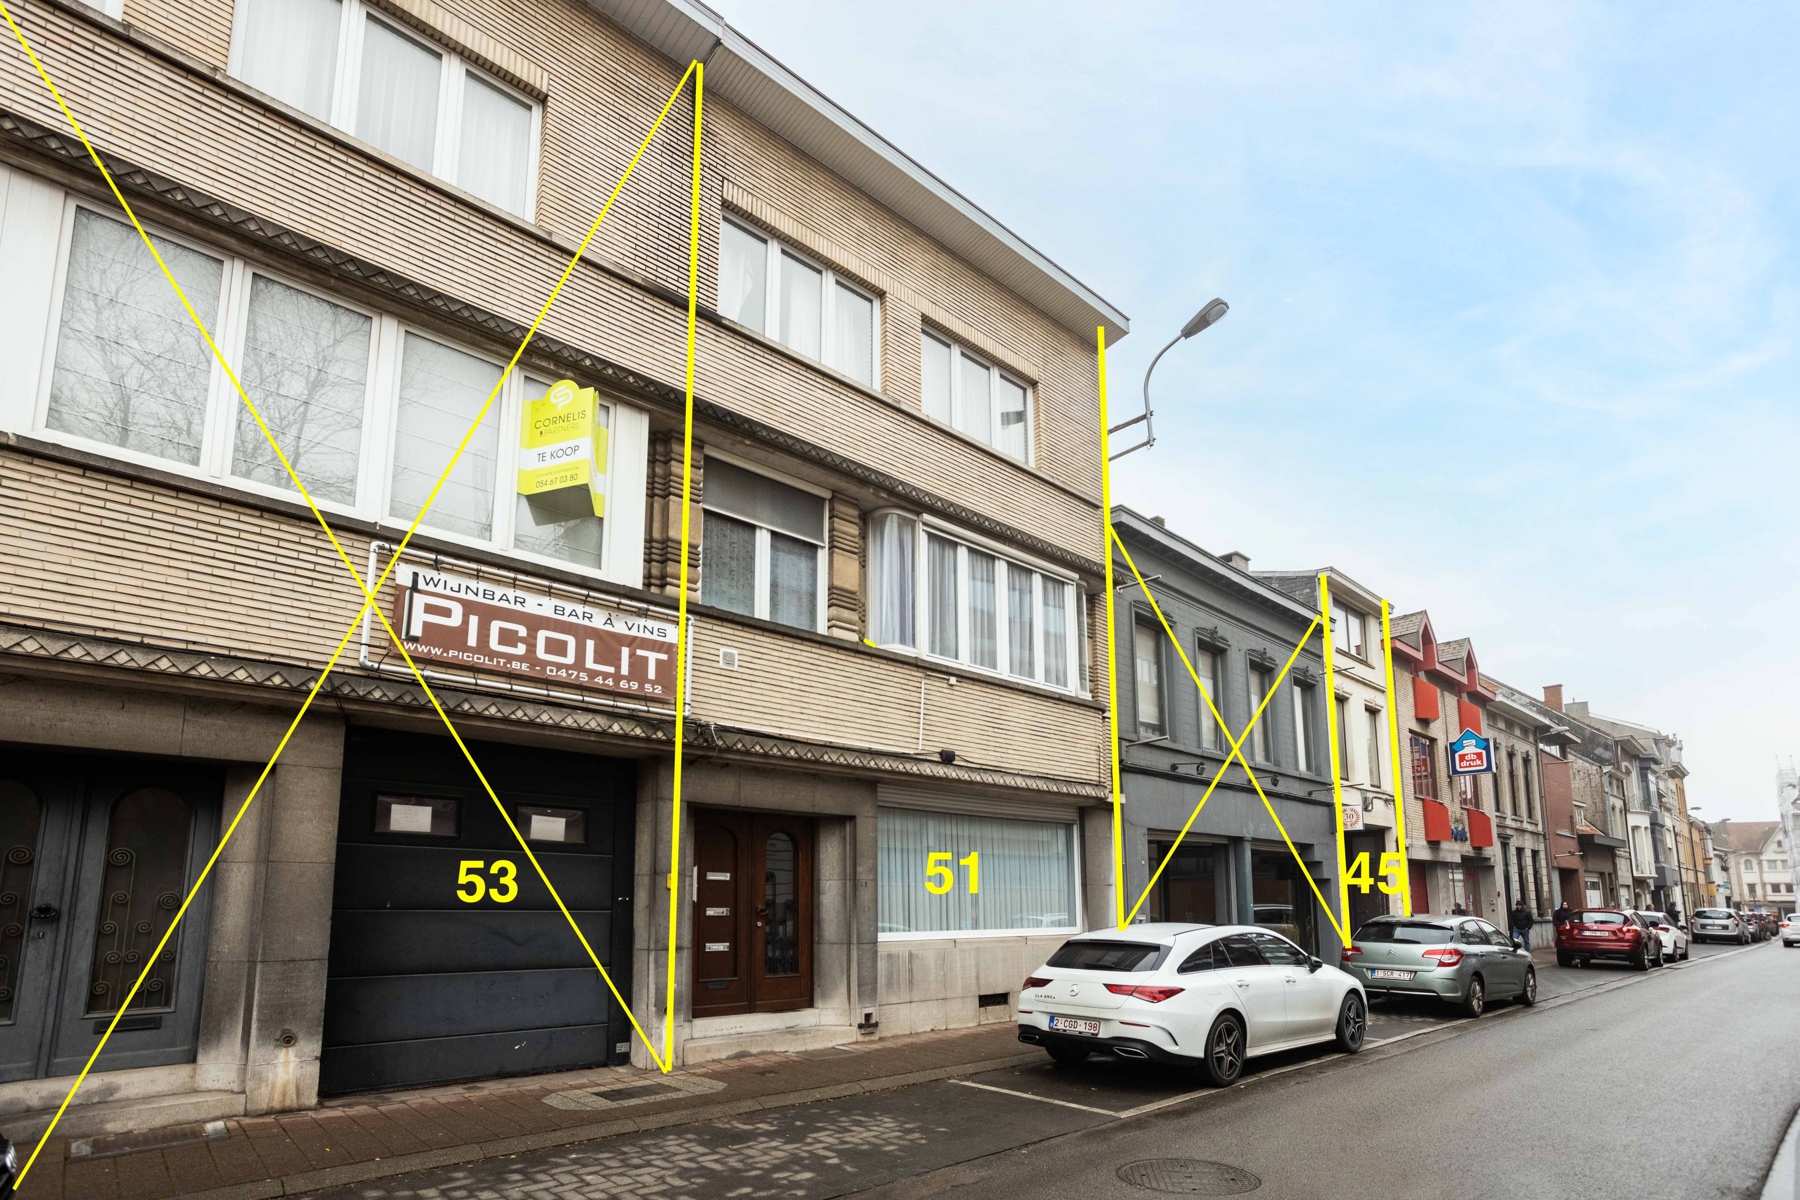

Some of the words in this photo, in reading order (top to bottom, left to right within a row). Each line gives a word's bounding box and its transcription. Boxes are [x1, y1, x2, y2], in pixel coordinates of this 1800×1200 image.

[534, 409, 587, 430] CORNELIS
[544, 422, 580, 436] PARTNERS
[537, 452, 547, 463] TE
[550, 445, 580, 460] KOOP
[535, 479, 548, 489] 054
[549, 476, 558, 486] 67
[560, 475, 568, 484] 03
[569, 473, 579, 482] 80
[422, 574, 526, 608] WIJNBAR
[554, 604, 594, 623] BAR
[603, 612, 615, 628] À
[624, 620, 668, 638] VINS
[546, 665, 589, 682] 0475
[594, 675, 614, 687] 44
[619, 679, 639, 690] 69
[644, 683, 663, 694] 52
[1460, 759, 1483, 767] druk
[1464, 753, 1477, 761] db
